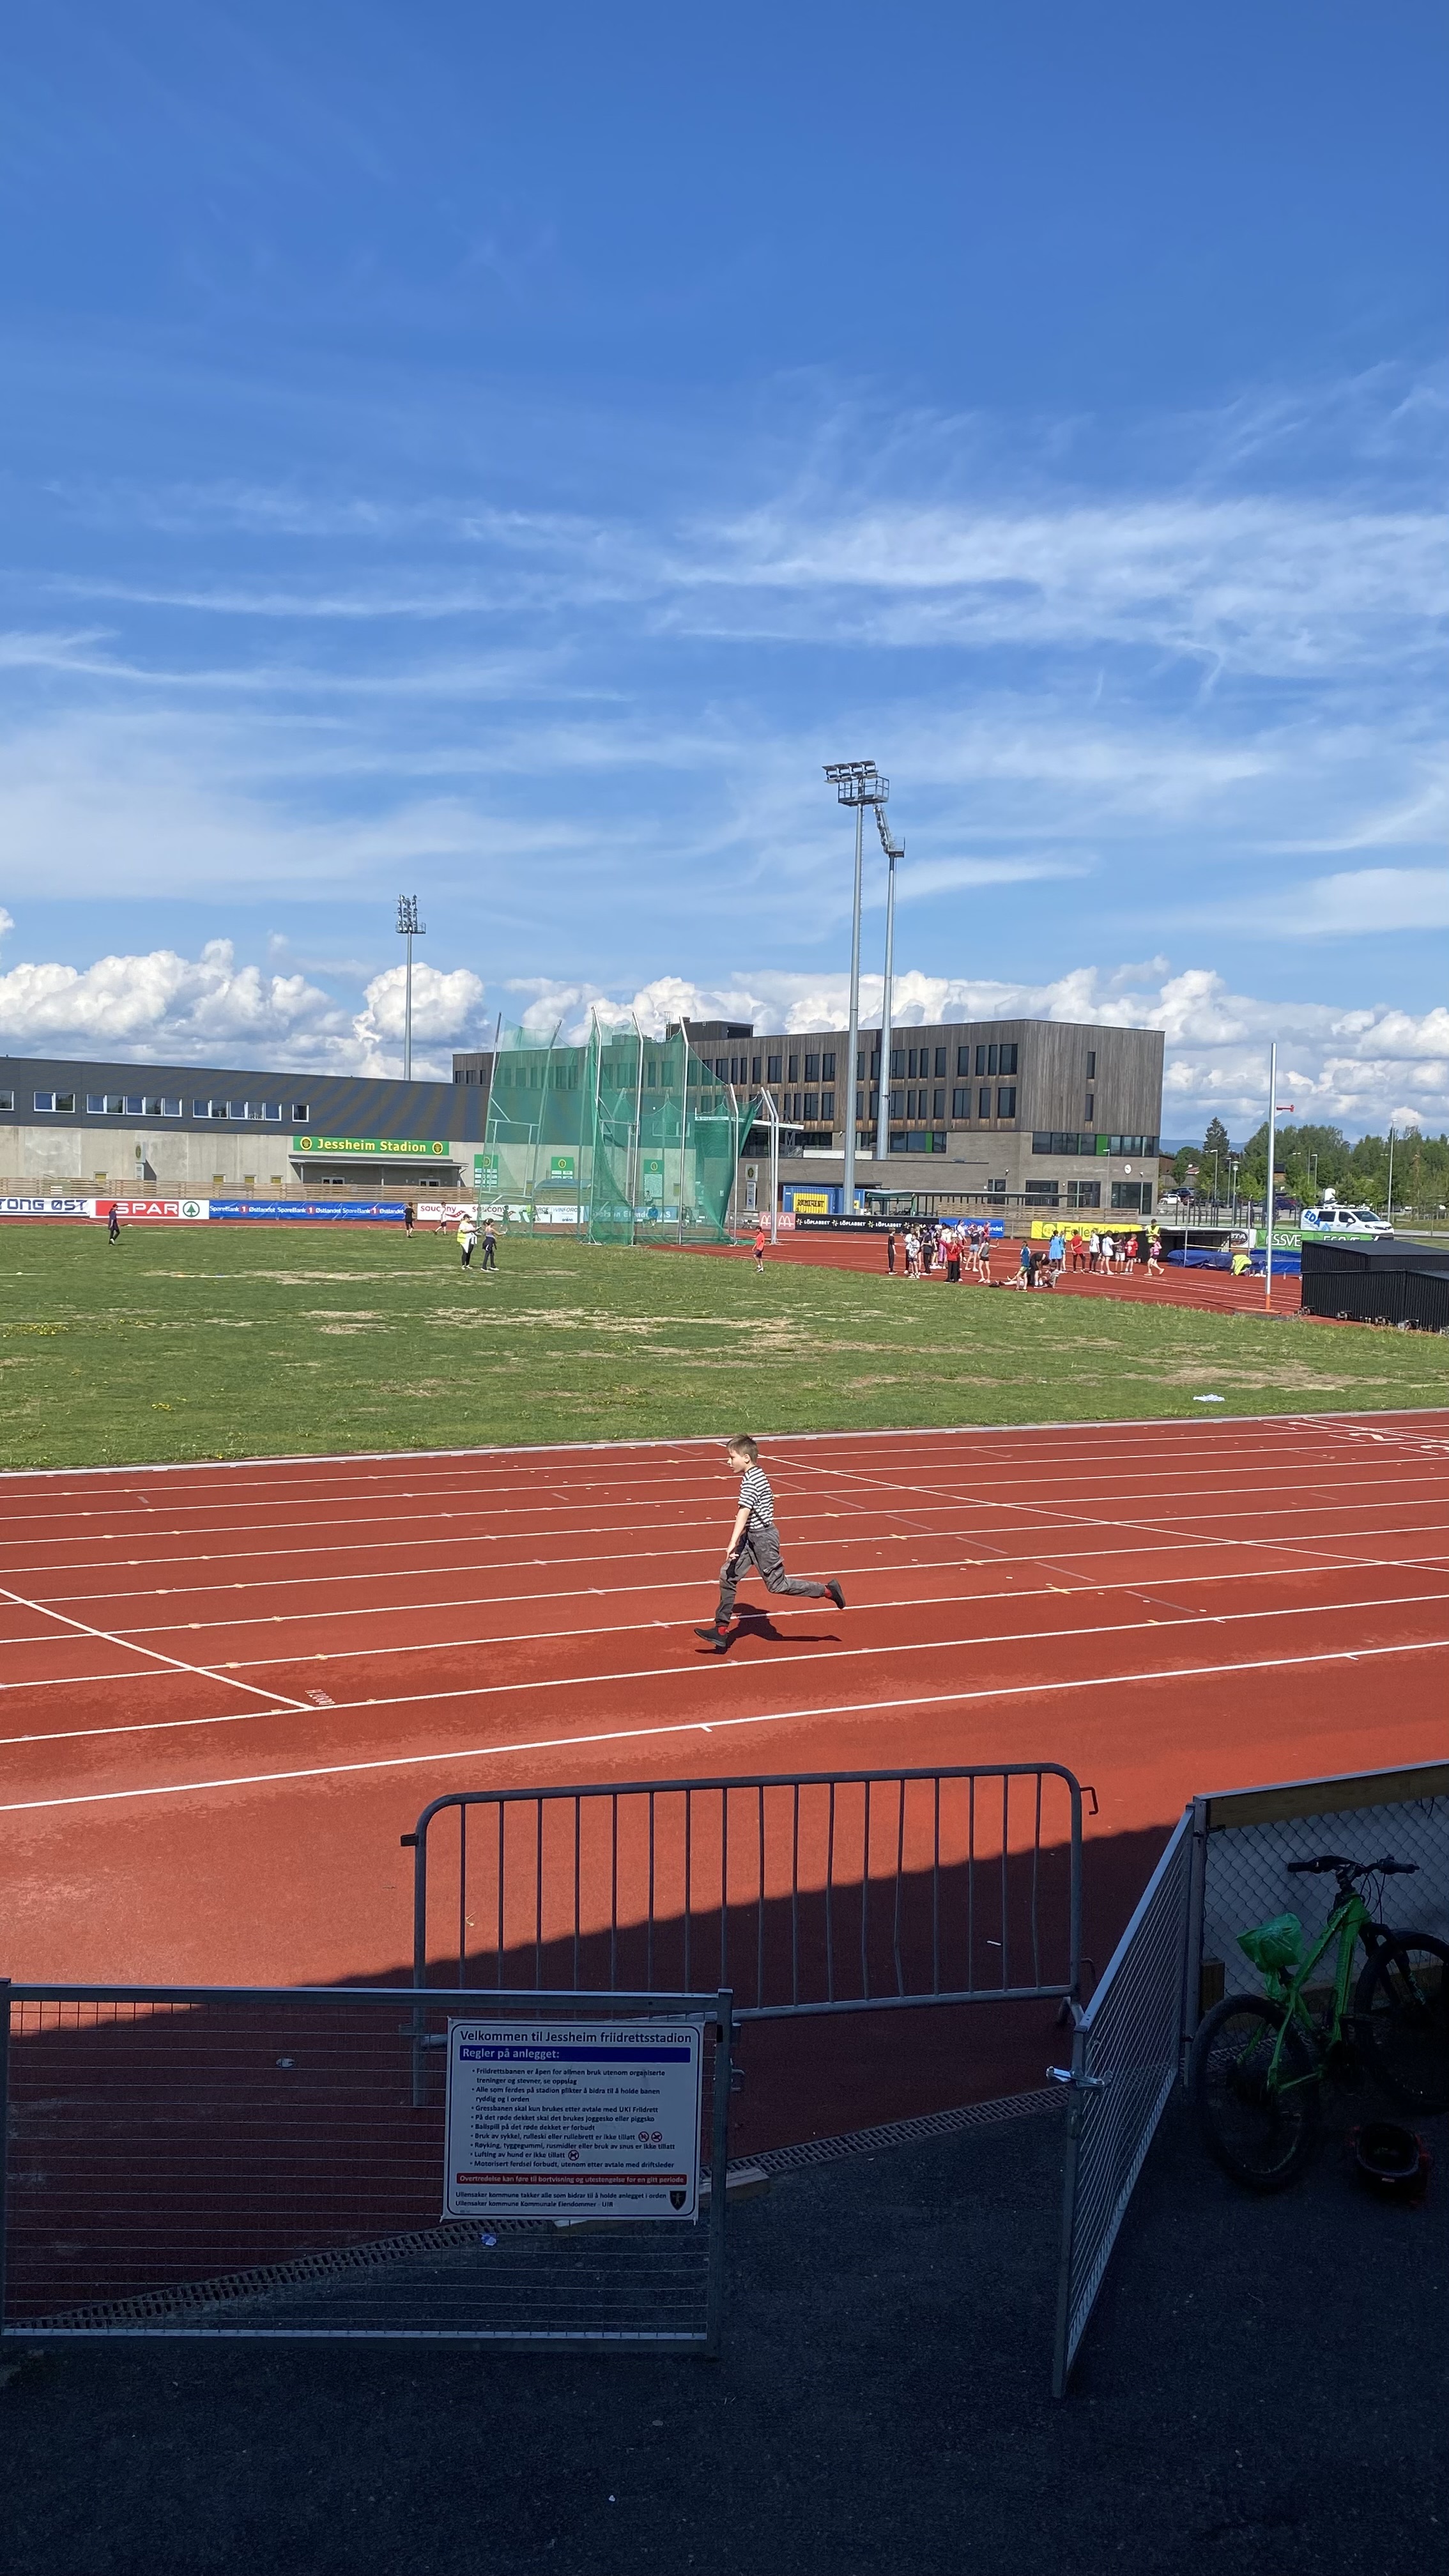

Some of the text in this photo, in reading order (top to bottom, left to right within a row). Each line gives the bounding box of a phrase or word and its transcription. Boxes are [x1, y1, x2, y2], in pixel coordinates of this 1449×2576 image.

[318, 1138, 426, 1152] Jessheim Stadion
[51, 1200, 86, 1211] ØST
[116, 1202, 178, 1214] SPAR
[420, 1205, 456, 1213] saucny
[459, 2029, 691, 2043] Velkommen til Jessheim friidrettsstadion
[463, 2047, 559, 2060] Regler på anlegget:
[534, 2067, 551, 2076] åpen
[629, 2069, 665, 2077] organiserte
[476, 2076, 506, 2085] treninger
[551, 2077, 577, 2085] oppslag
[526, 2086, 535, 2094] på
[475, 2095, 496, 2103] ryddig
[585, 2115, 613, 2123] joggesko
[630, 2115, 655, 2123] piggsko
[474, 2122, 500, 2131] Ballspill
[500, 2122, 509, 2131] på
[503, 2142, 545, 2150] tyggegummi,
[546, 2142, 577, 2150] rusmidler
